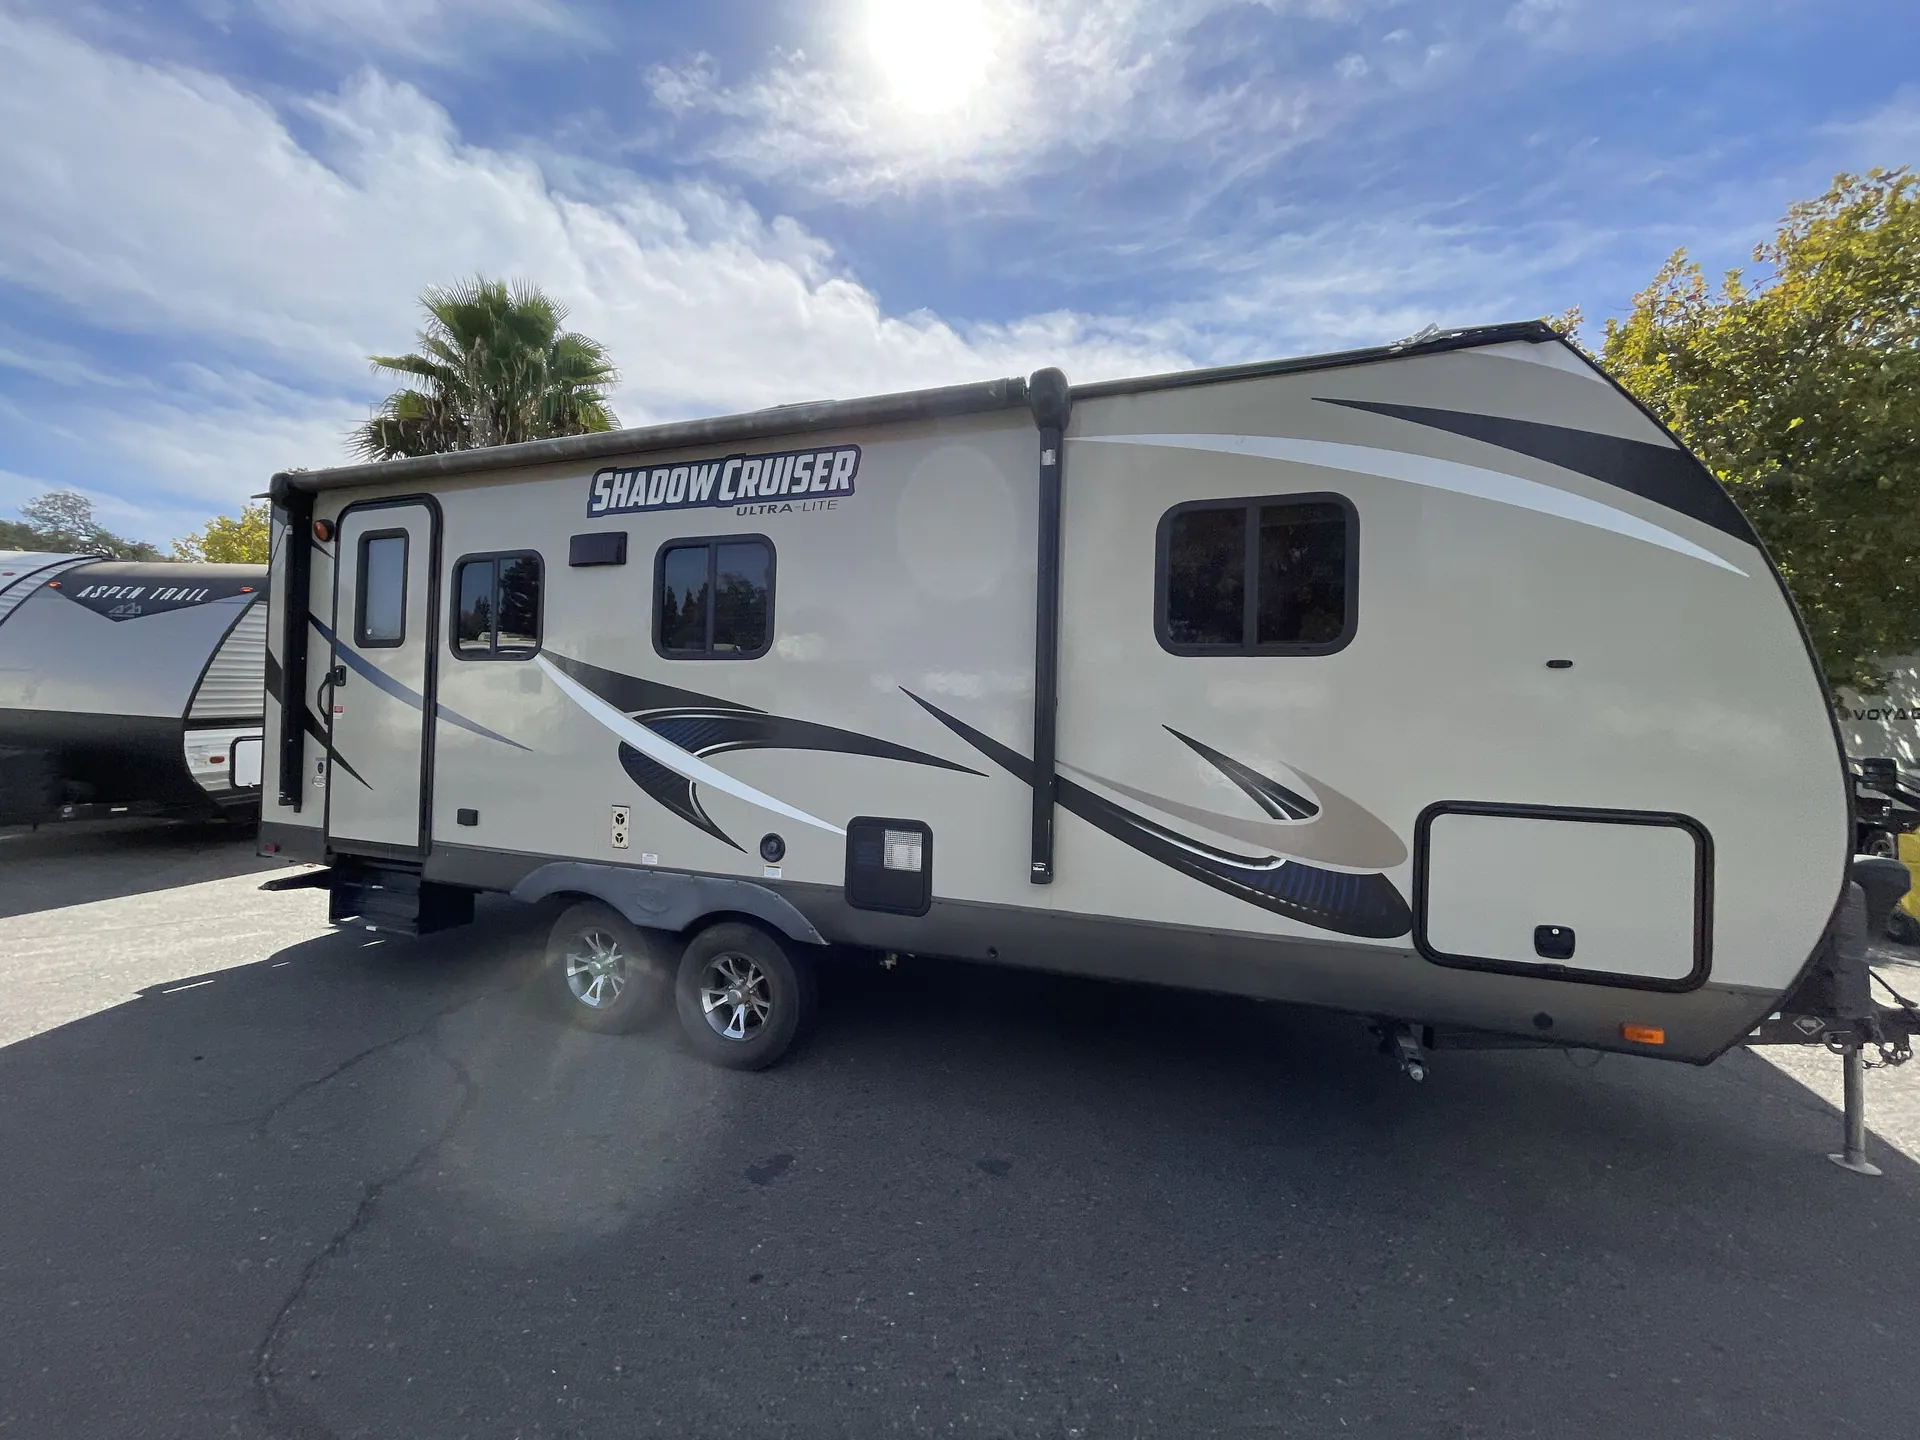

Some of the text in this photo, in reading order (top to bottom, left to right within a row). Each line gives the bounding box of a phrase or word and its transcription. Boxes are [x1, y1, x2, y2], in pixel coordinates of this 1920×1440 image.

[592, 450, 857, 512] SHADOW CRUISER
[736, 500, 838, 516] ULTRA-LITE
[76, 585, 209, 601] ASPEN TRAIL
